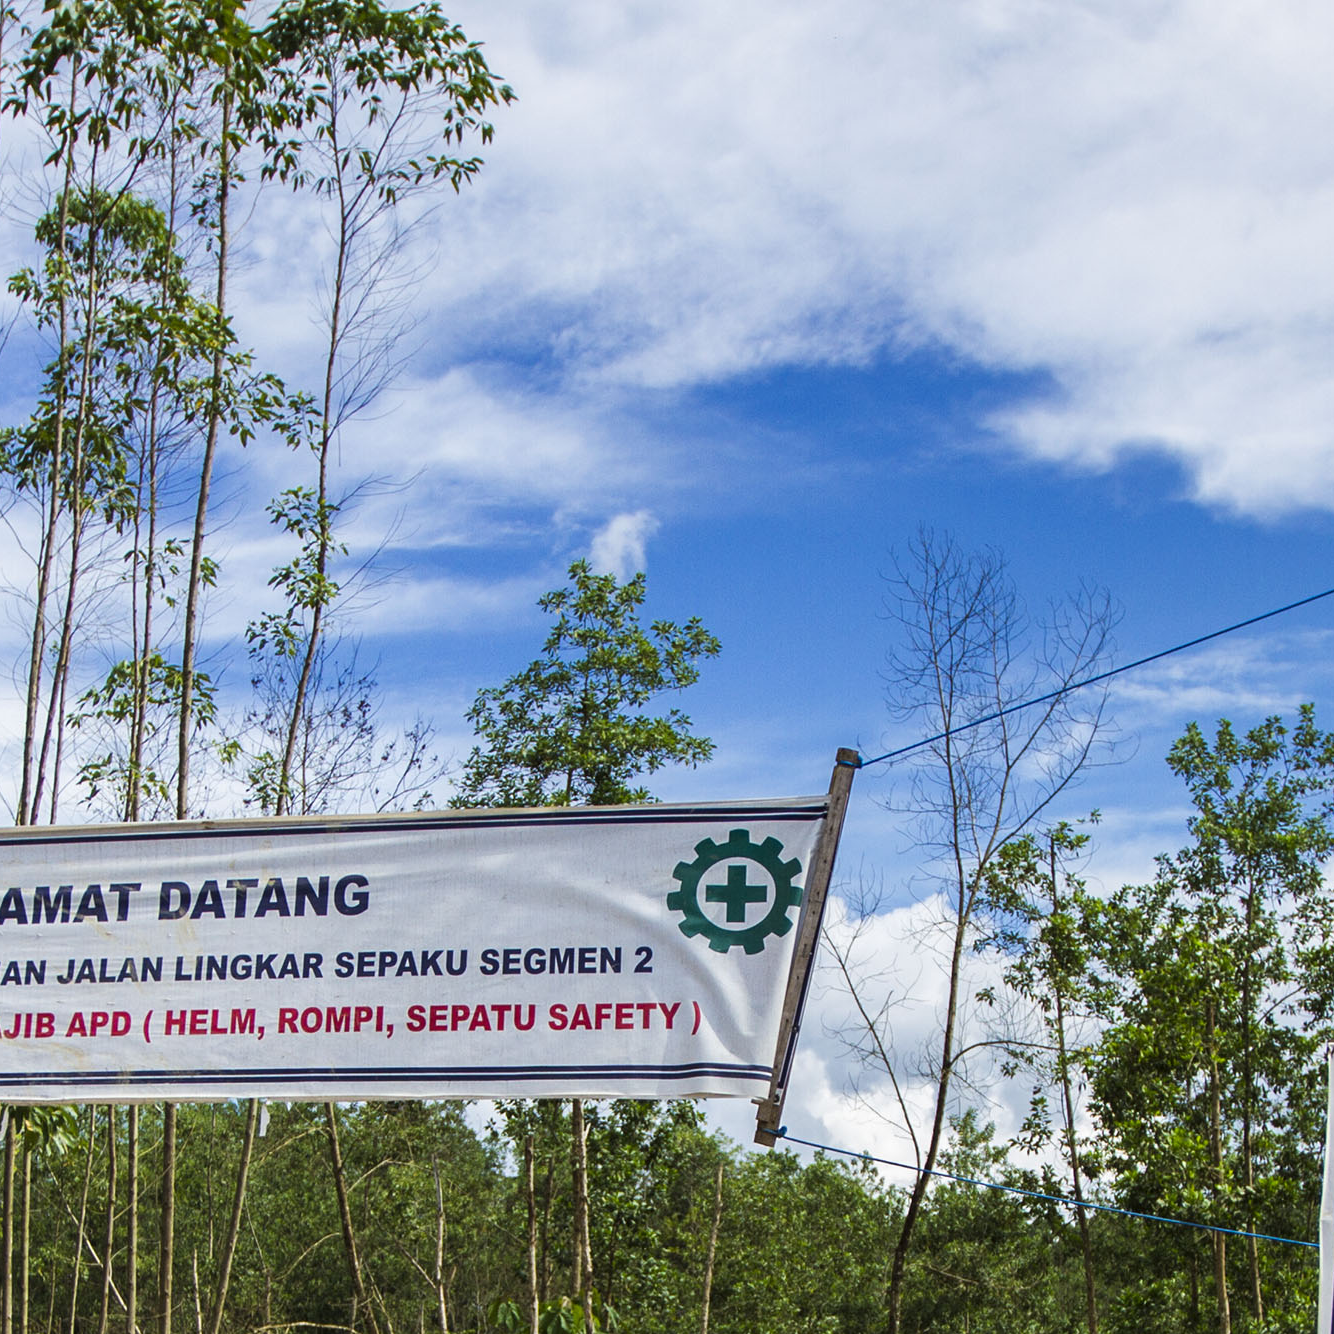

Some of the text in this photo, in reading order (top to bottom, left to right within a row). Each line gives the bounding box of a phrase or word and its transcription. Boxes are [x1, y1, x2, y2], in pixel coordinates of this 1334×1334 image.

[158, 874, 370, 921] DATANG
[56, 956, 163, 984] JALAN
[174, 953, 324, 982] LINGKAR
[334, 949, 468, 978] SEPAKU
[479, 947, 622, 975] SEGMEN
[633, 946, 654, 974] 2
[65, 1011, 132, 1037] APD
[165, 1008, 266, 1041] HELM,
[277, 1006, 394, 1039] ROMPI,
[406, 1003, 536, 1032] SEPATU
[548, 1002, 682, 1031] SAFETY
